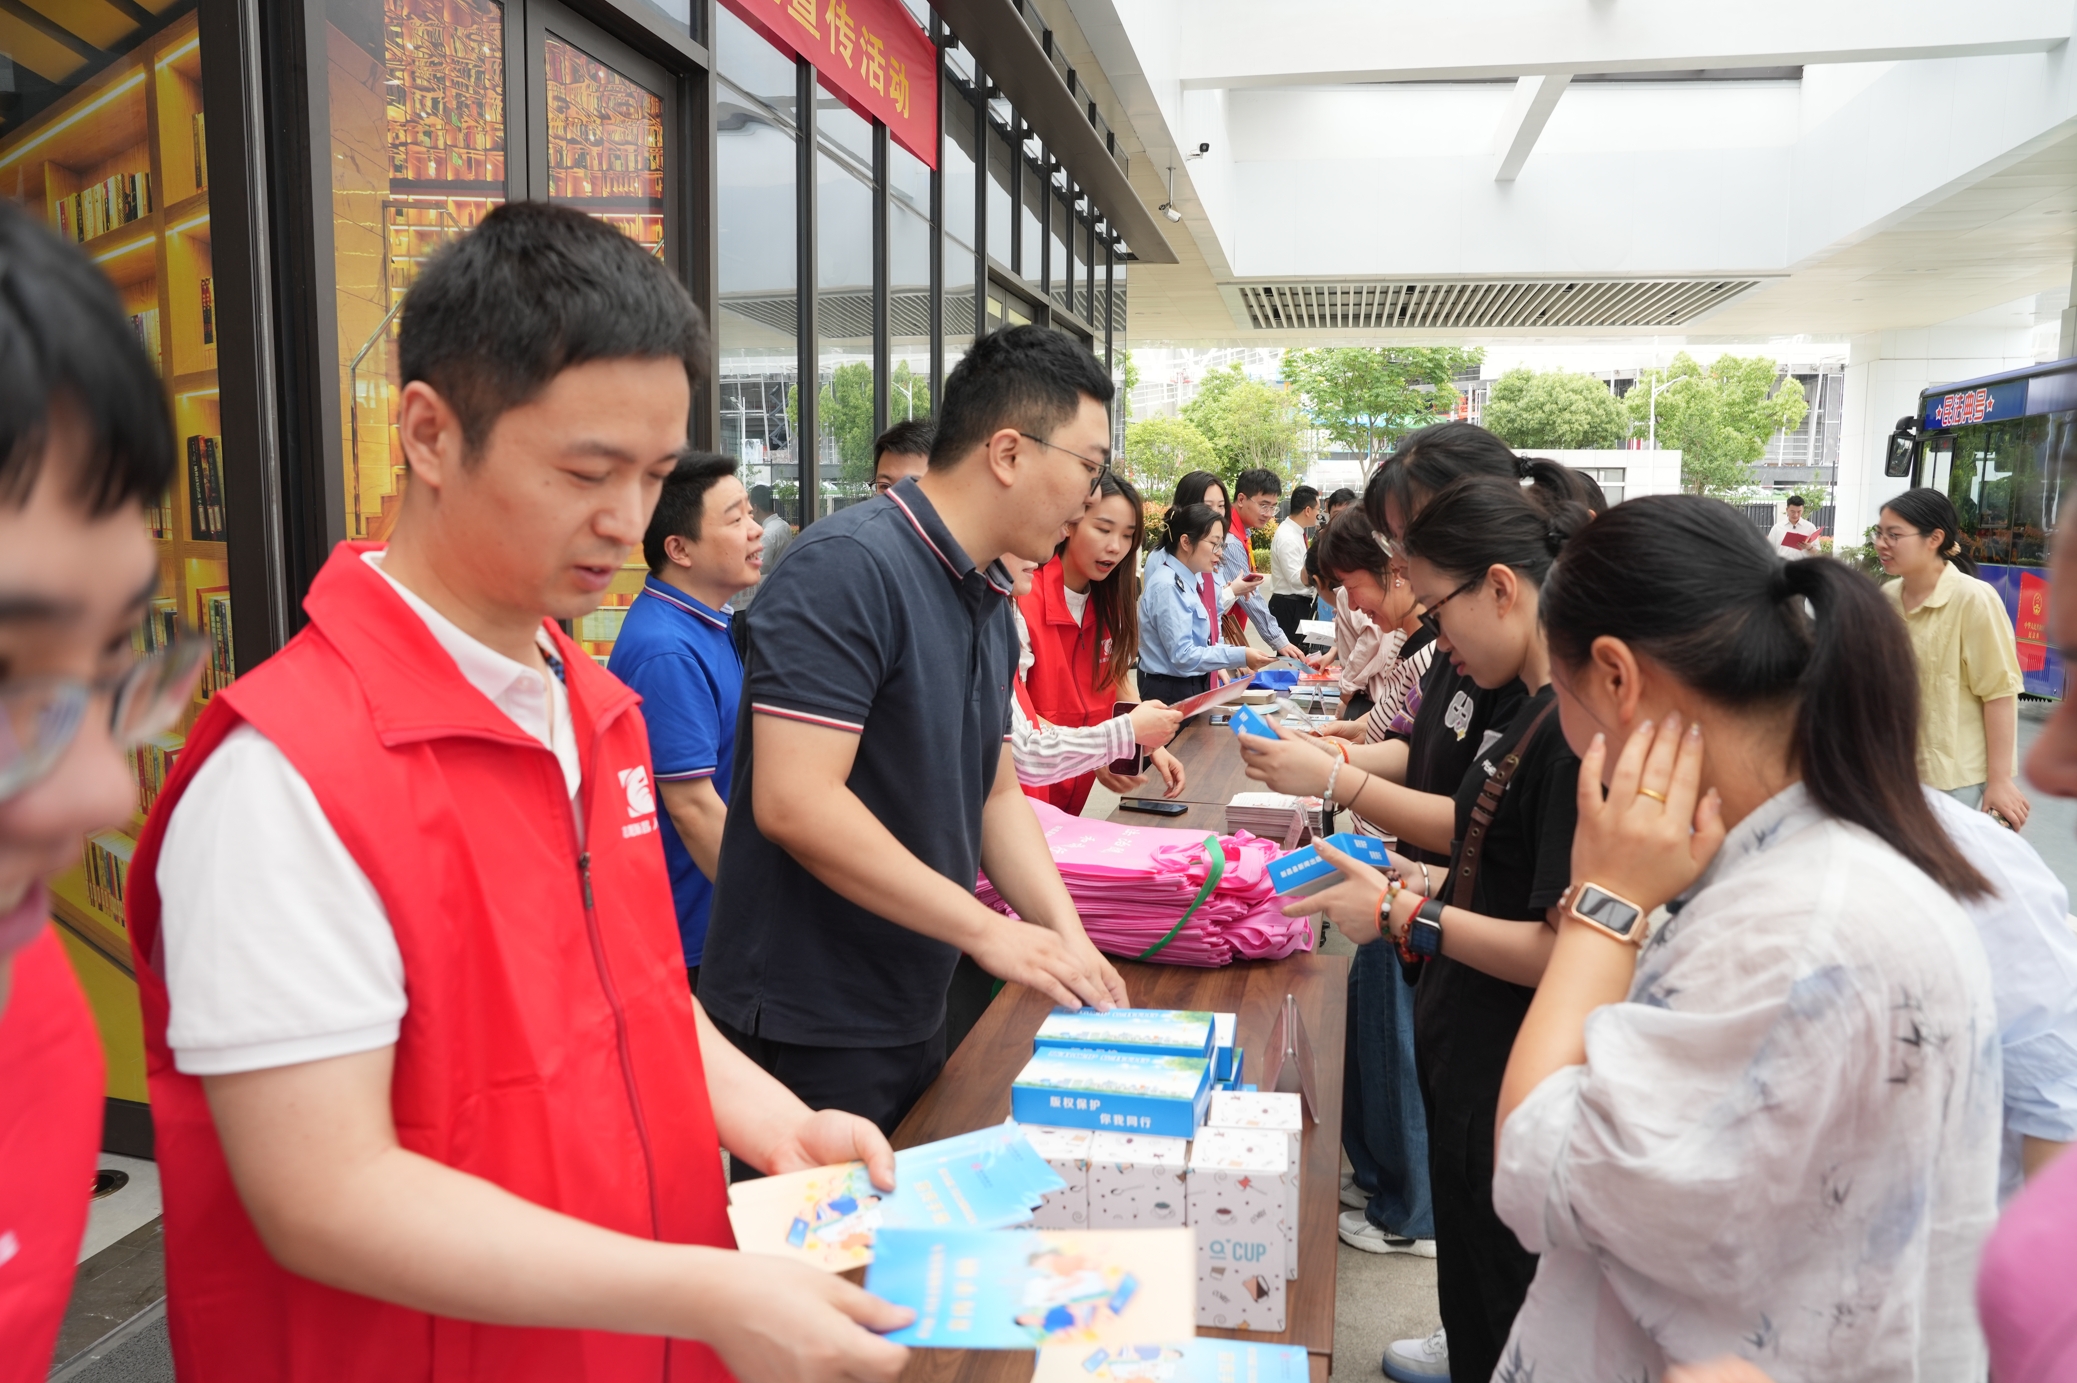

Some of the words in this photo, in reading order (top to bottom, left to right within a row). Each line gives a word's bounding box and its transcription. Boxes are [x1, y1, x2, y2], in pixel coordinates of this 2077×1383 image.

[1942, 388, 1987, 427] 民法典号
[1050, 1095, 1101, 1111] 版权保护
[1100, 1113, 1151, 1129] 你我同行
